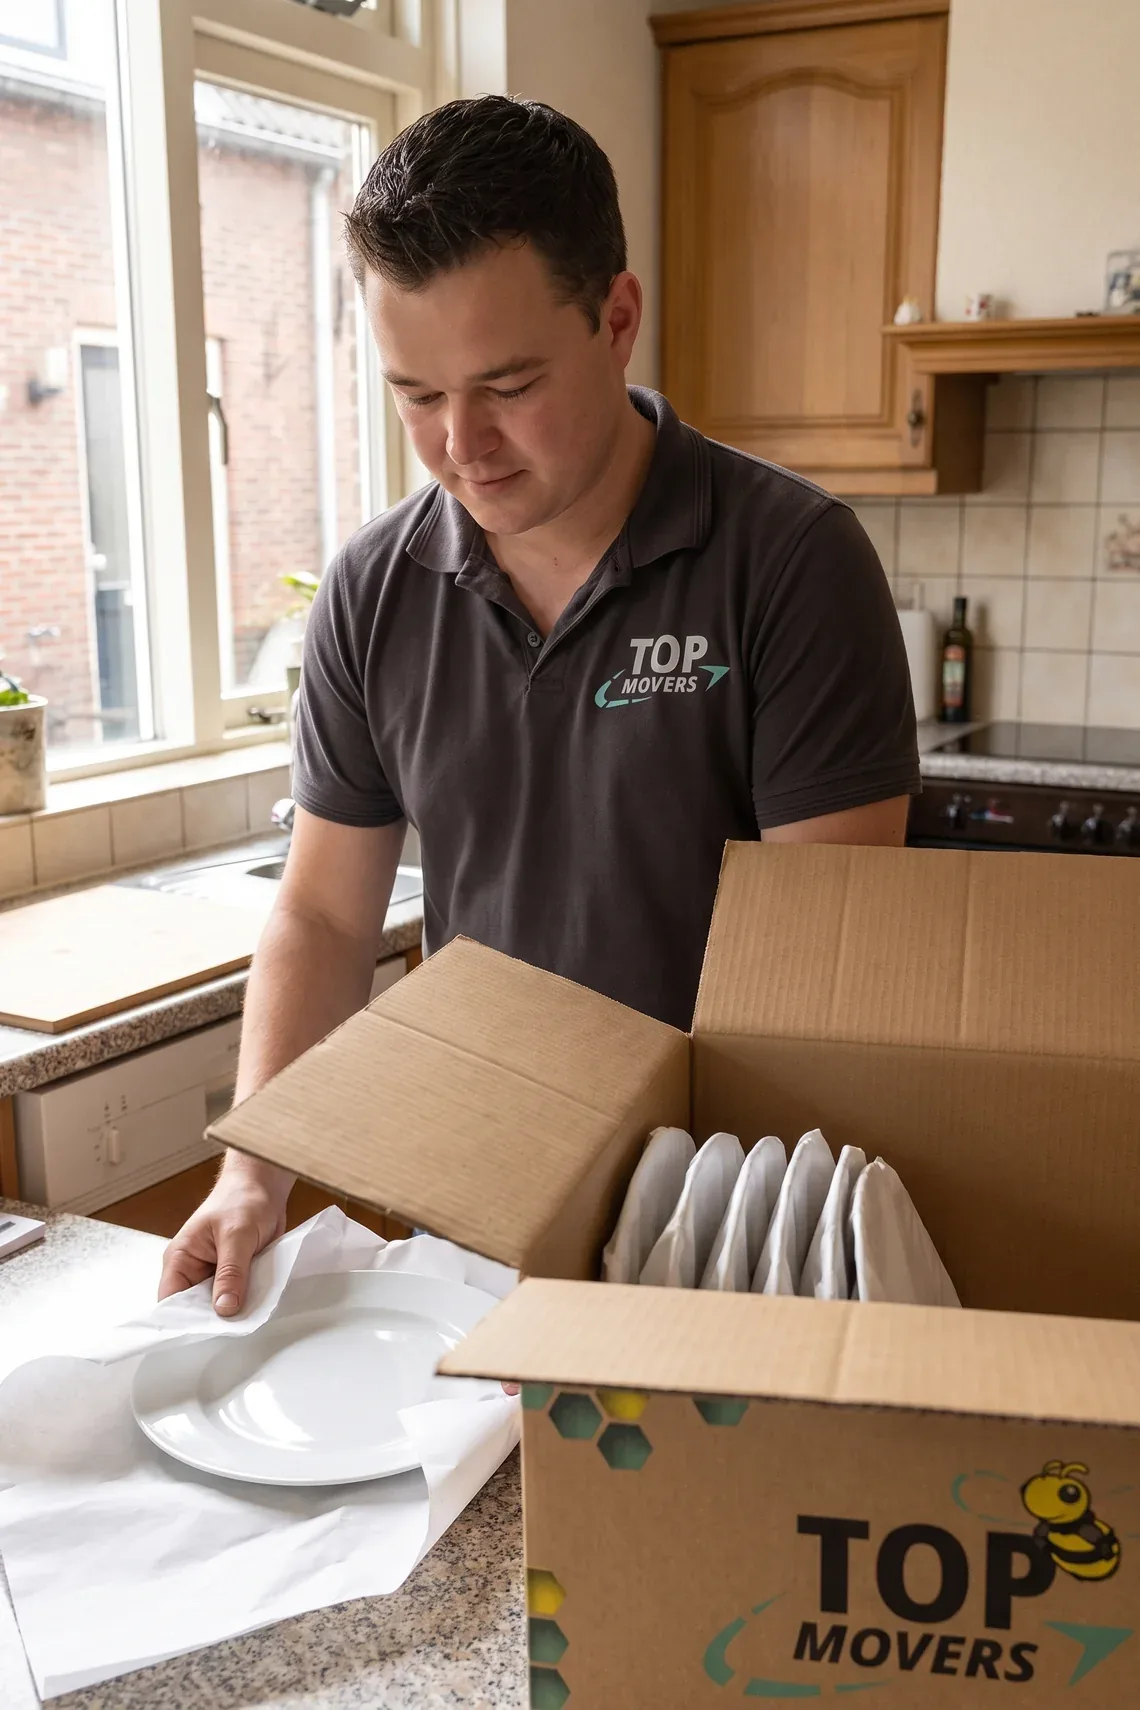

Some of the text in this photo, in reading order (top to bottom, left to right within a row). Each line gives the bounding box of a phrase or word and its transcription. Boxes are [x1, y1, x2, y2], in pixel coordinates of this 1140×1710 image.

[629, 634, 709, 675] TOP
[621, 676, 698, 694] MOVERS
[797, 1514, 1057, 1630] TOP
[793, 1621, 1039, 1683] MOVERS
